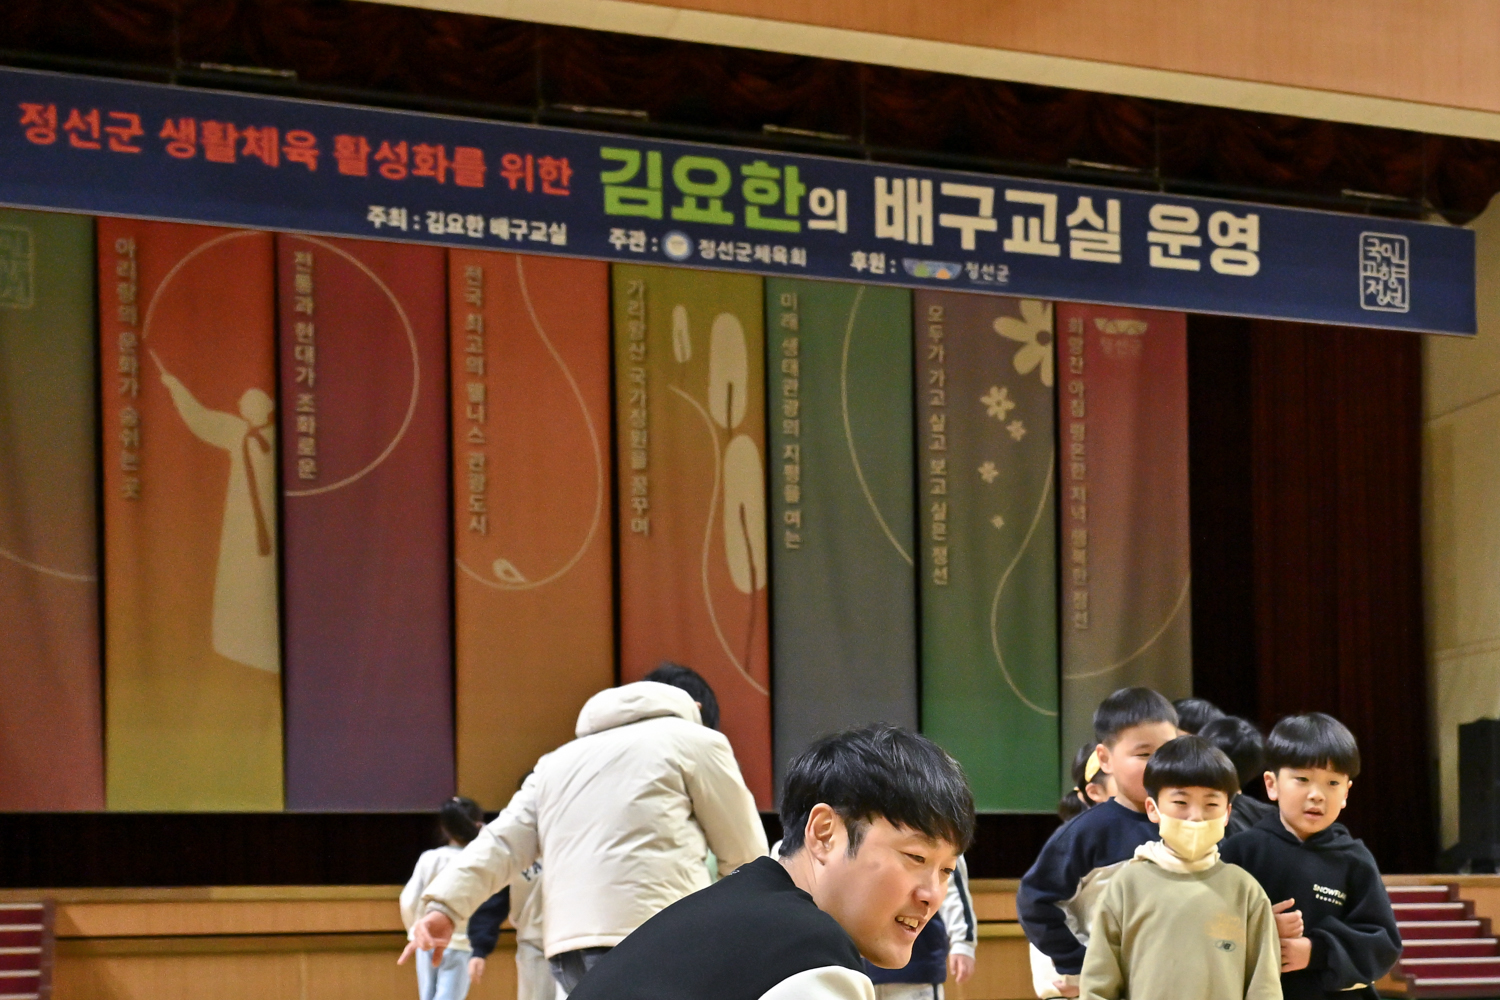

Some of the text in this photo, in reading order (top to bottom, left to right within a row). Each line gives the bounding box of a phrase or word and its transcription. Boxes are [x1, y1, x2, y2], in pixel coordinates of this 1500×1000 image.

[18, 103, 1261, 277] 정선군 생활체육 활성화를 위한 김요한의 배구교실 운영
[426, 210, 485, 238] 김요한
[489, 216, 568, 246] 배구교실
[697, 238, 807, 267] 정선군체육회
[965, 261, 1010, 283] 정선군
[627, 279, 646, 361] 가리왕산
[928, 305, 945, 363] 모두가
[931, 546, 949, 585] 정선
